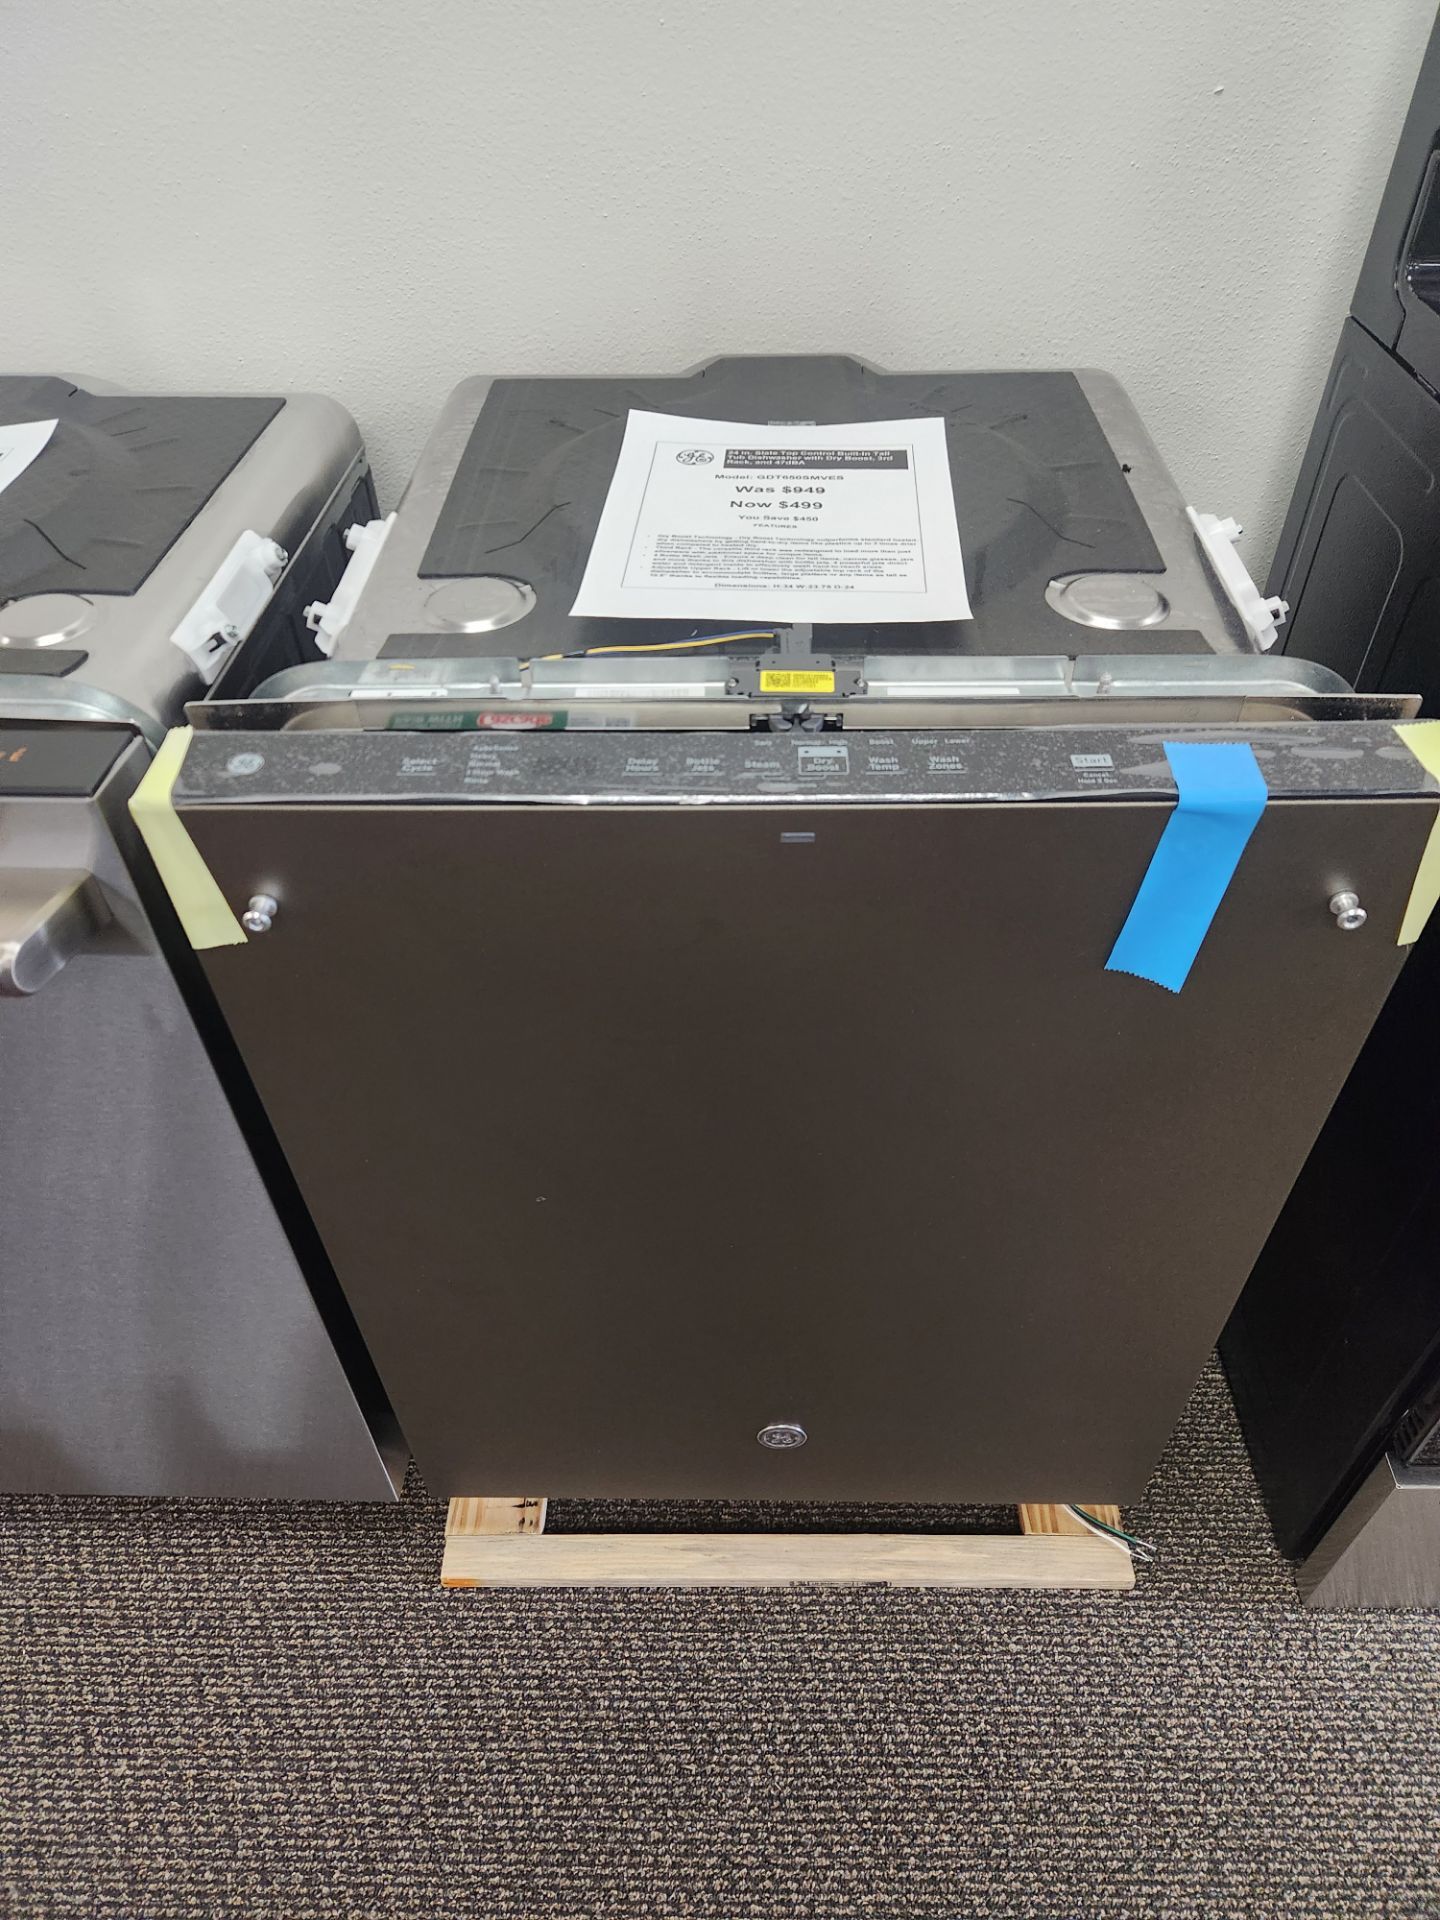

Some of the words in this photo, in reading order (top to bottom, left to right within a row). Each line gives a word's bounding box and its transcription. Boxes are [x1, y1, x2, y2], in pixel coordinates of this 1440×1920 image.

[736, 485, 776, 494] Was
[782, 485, 826, 495] $949
[730, 500, 773, 508] Now
[778, 501, 823, 510] $499
[813, 757, 835, 766] Dry
[867, 756, 899, 764] Wash
[928, 755, 960, 764] Wash
[1075, 756, 1106, 764] Start
[806, 764, 840, 772] Boost
[869, 763, 900, 771] Temp
[927, 763, 964, 771] Zones
